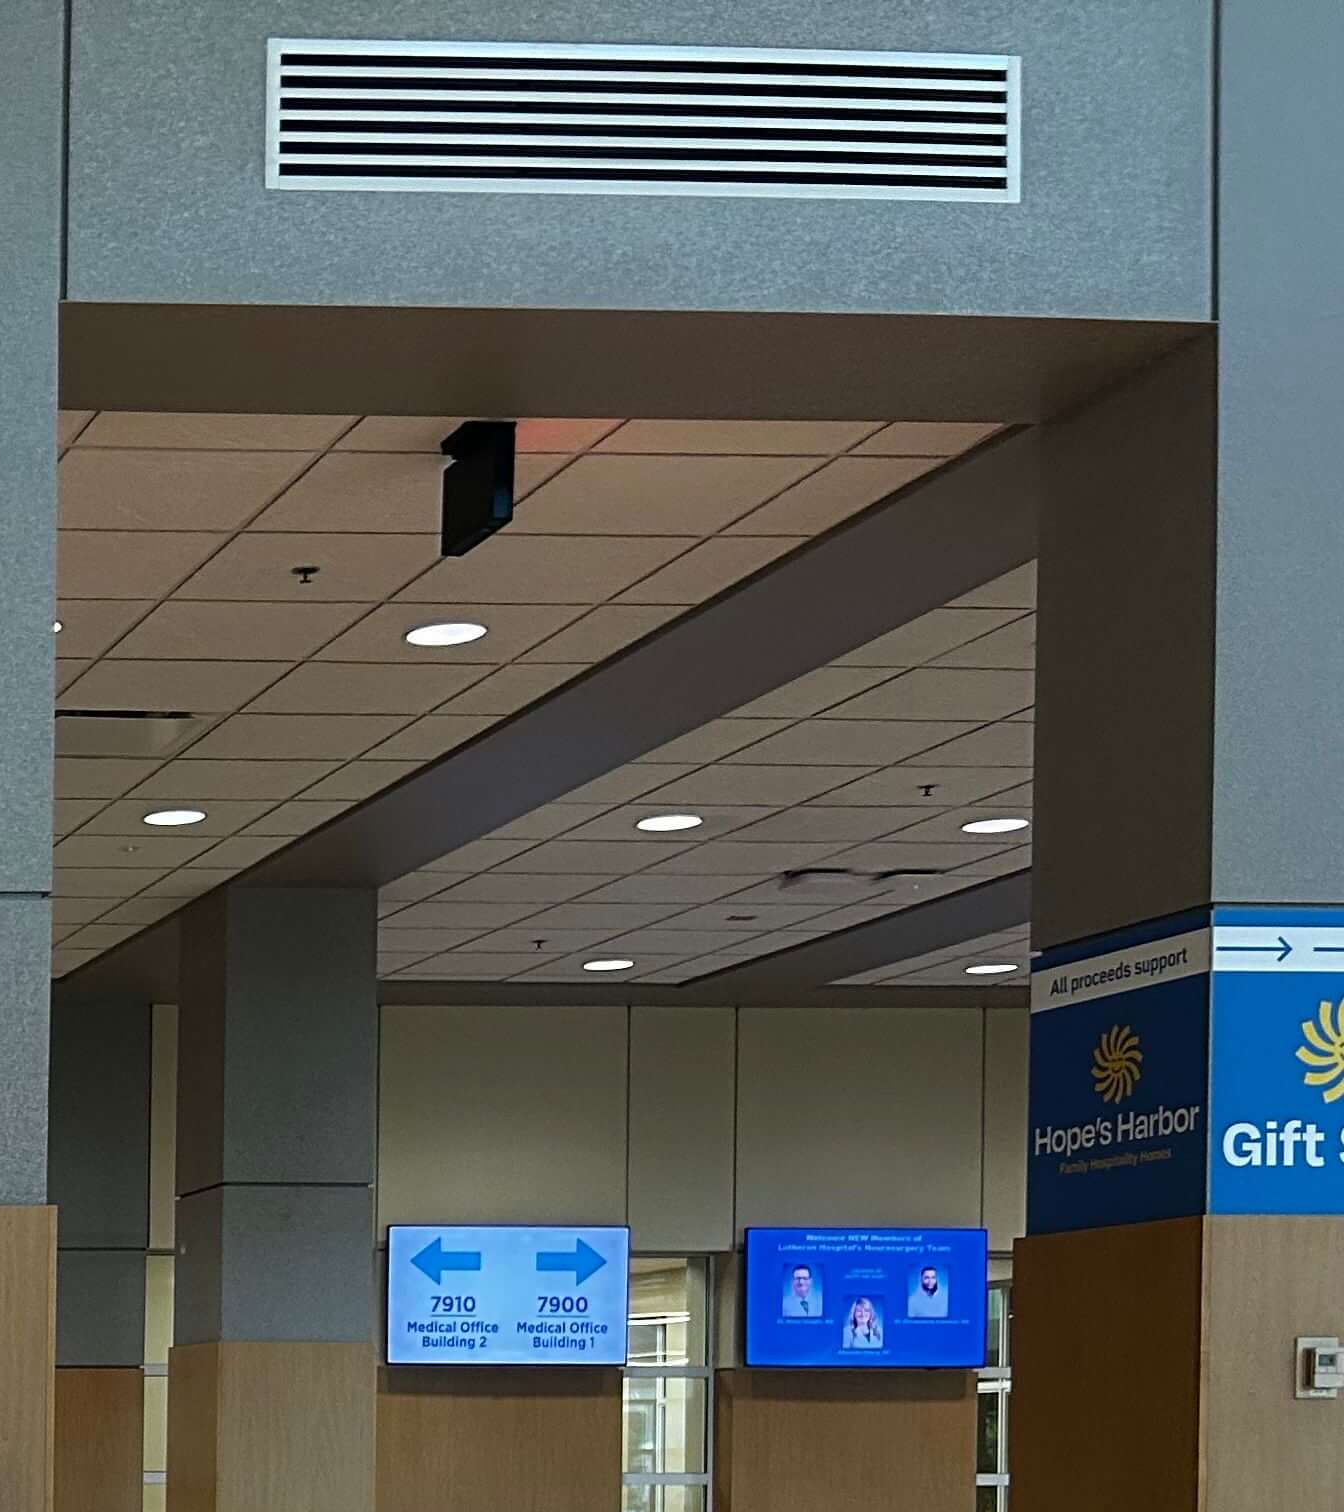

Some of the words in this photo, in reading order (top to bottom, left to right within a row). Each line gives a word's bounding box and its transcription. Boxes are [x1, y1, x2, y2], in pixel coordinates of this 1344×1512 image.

[1050, 979, 1067, 996] All
[1072, 962, 1131, 995] proceeds
[1135, 949, 1187, 976] support
[1035, 1118, 1112, 1156] Hope's
[1117, 1106, 1200, 1142] Harbor
[1224, 1120, 1326, 1167] Gift
[431, 1296, 476, 1312] 7910
[538, 1297, 588, 1312] 7900
[408, 1322, 456, 1333] Medical
[461, 1322, 499, 1333] Office
[517, 1323, 565, 1333] Medical
[570, 1323, 608, 1334] Office
[422, 1336, 475, 1349] Building
[479, 1337, 487, 1347] 2
[533, 1337, 586, 1349] Building
[590, 1338, 594, 1348] 1
